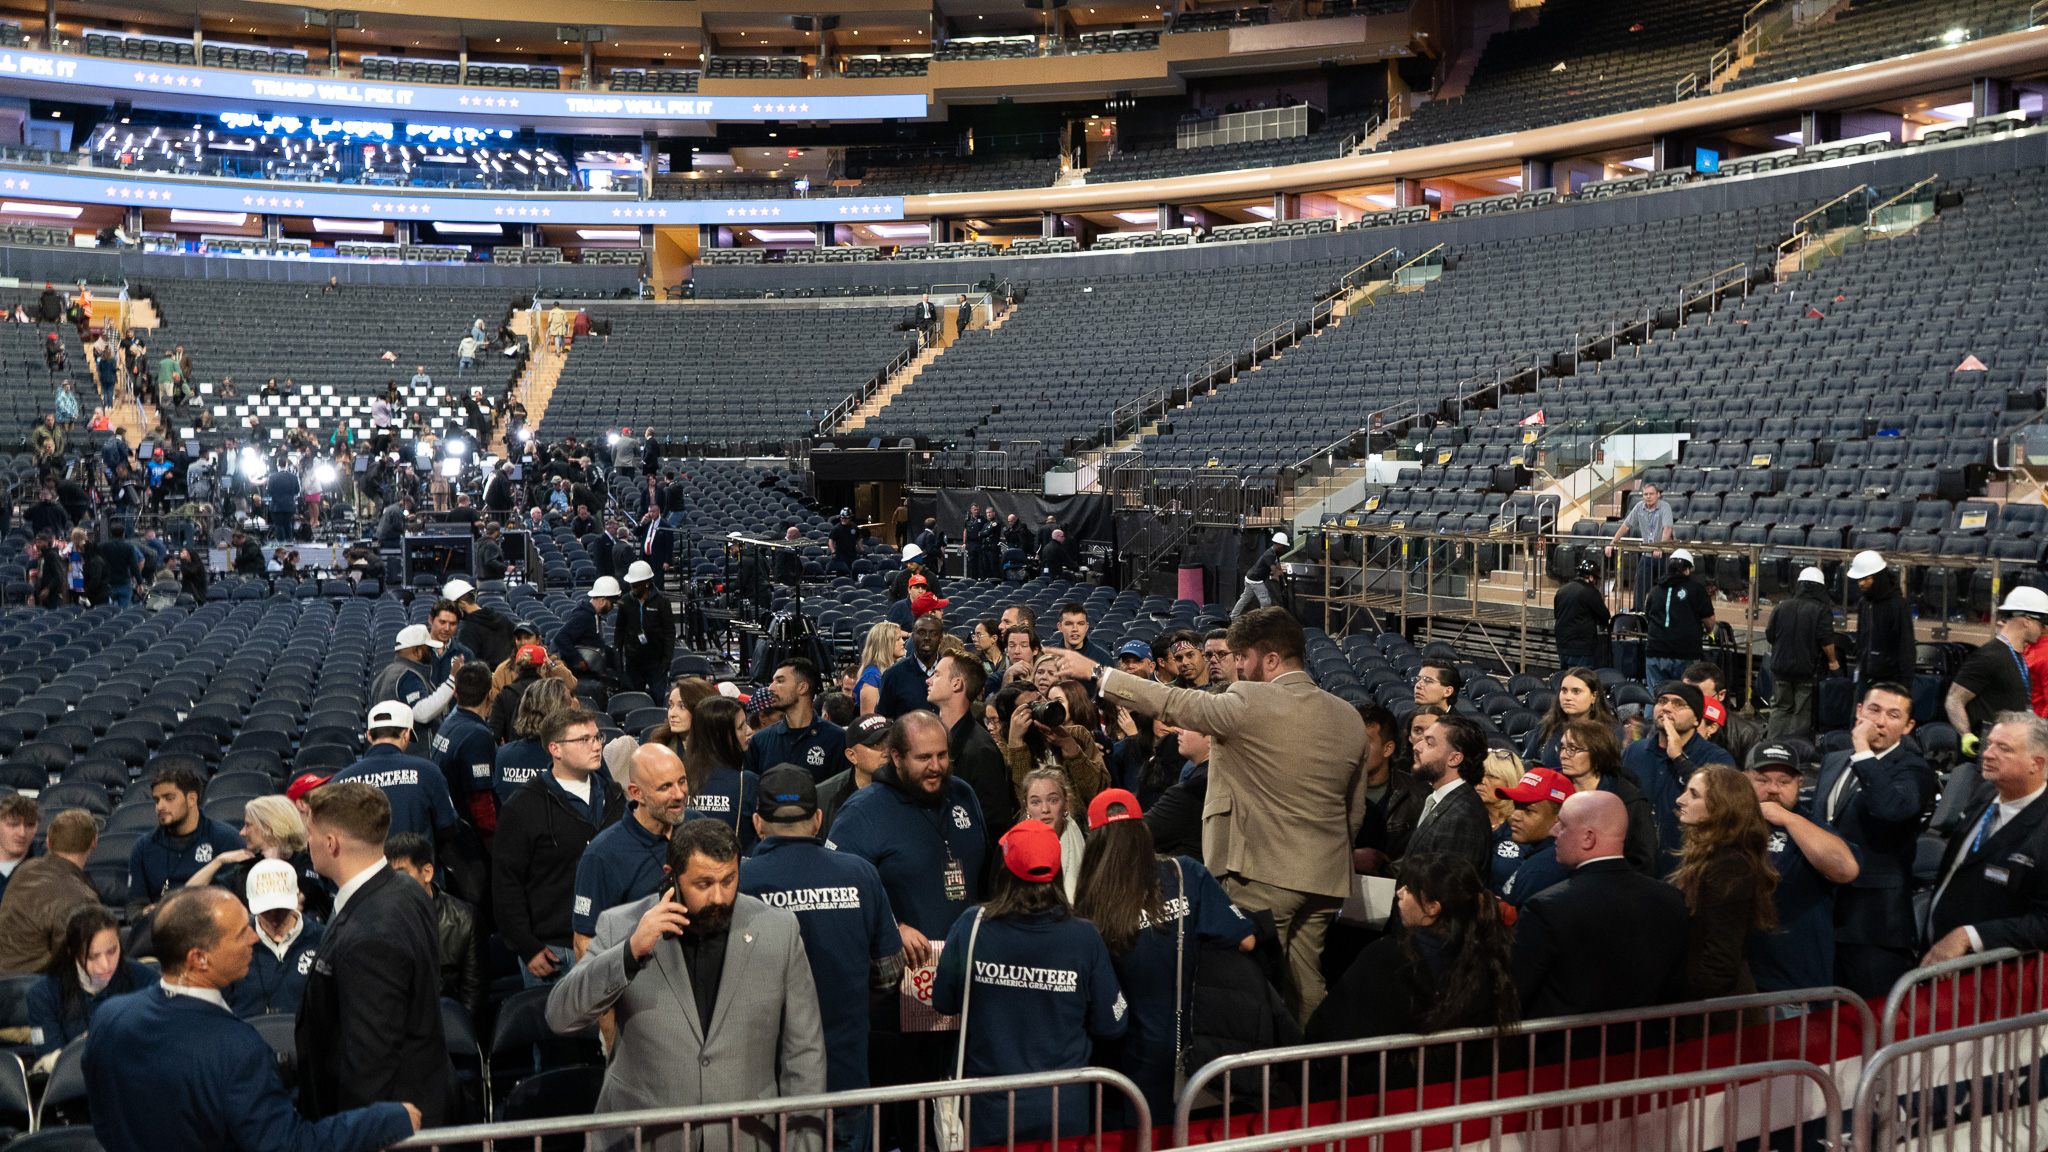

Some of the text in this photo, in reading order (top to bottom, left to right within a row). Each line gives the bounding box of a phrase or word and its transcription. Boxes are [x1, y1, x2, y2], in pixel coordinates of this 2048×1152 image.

[20, 56, 54, 75] FIX
[57, 60, 77, 78] IT
[251, 79, 414, 105] TRUMP WILL FIX IT
[566, 98, 713, 114] TRUMP WILL FIX IT
[859, 716, 887, 730] TRUMP
[339, 769, 418, 785] OLUNTEER
[503, 767, 548, 778] VOLUN
[687, 795, 730, 808] NTEER
[761, 887, 860, 907] VOLUNTEER
[816, 901, 838, 910] GREAT
[913, 969, 936, 990] PO
[975, 960, 1078, 986] VOLUNTEER
[975, 975, 994, 985] MAKE
[994, 979, 1028, 989] AMERICA
[1028, 981, 1052, 991] GREAT
[917, 984, 934, 1001] CO
